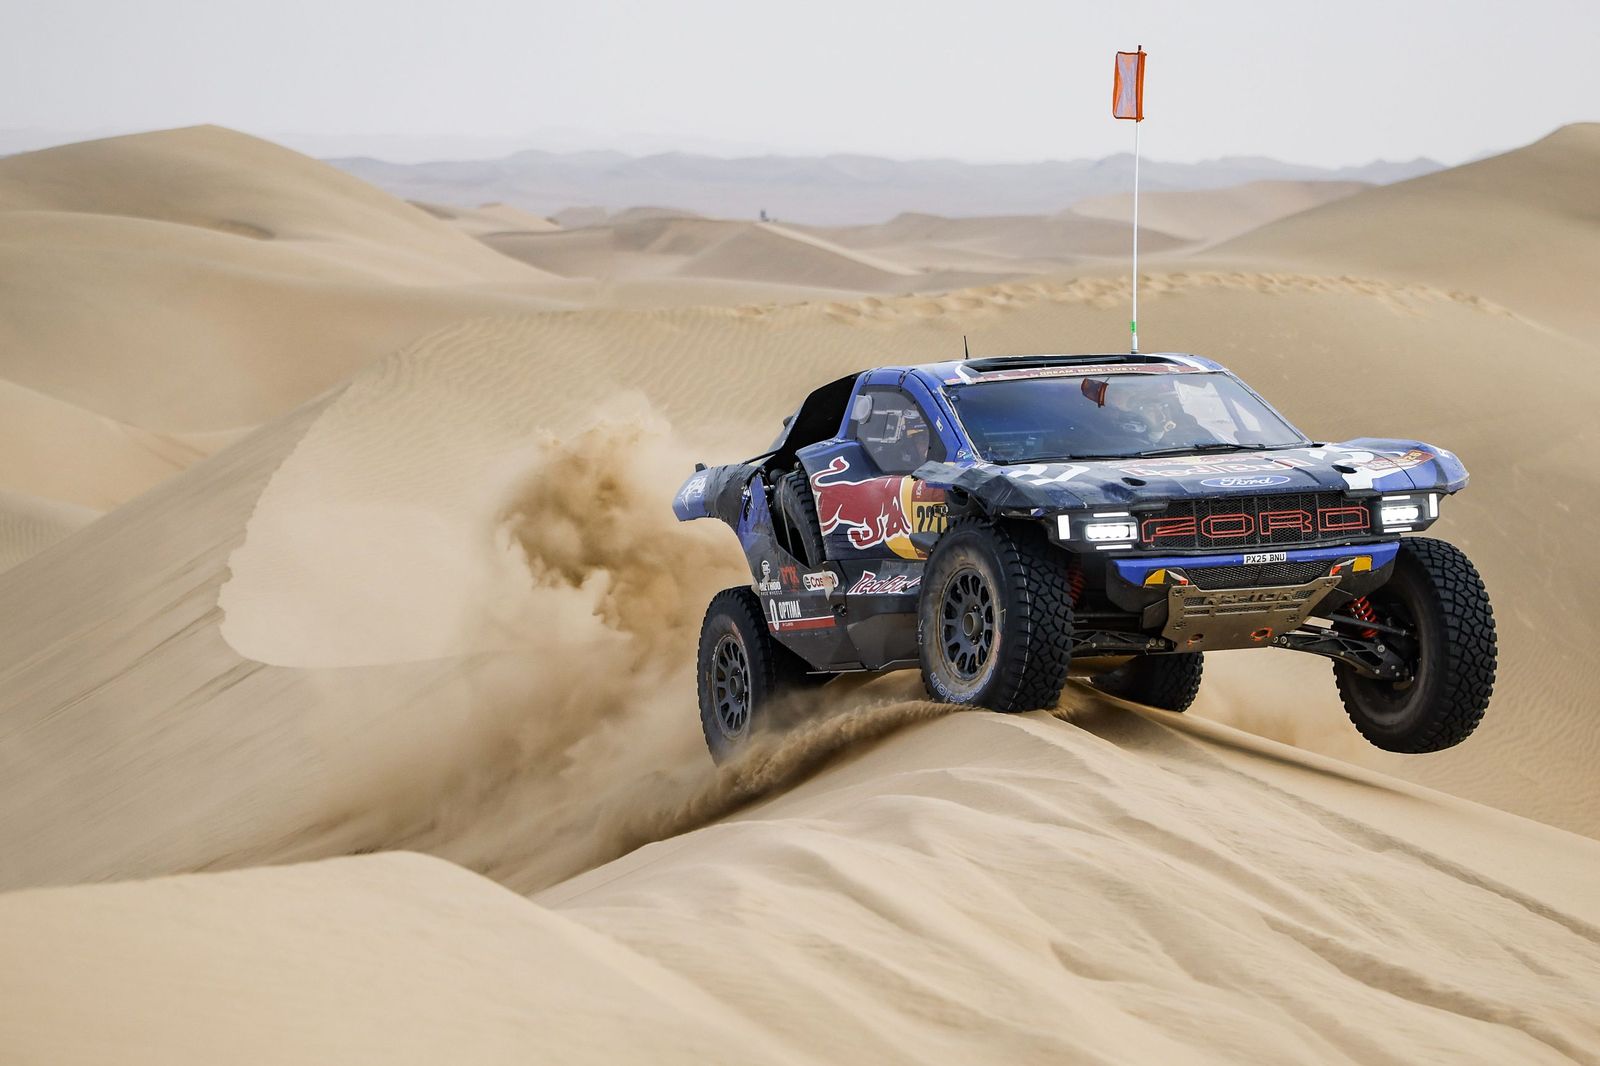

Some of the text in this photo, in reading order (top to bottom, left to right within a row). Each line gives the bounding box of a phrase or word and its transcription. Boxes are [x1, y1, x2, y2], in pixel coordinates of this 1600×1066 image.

[1220, 476, 1273, 486] Ford
[1141, 506, 1371, 543] FORD
[1245, 554, 1285, 563] PX25 BNU
[778, 600, 802, 620] OPTIMA
